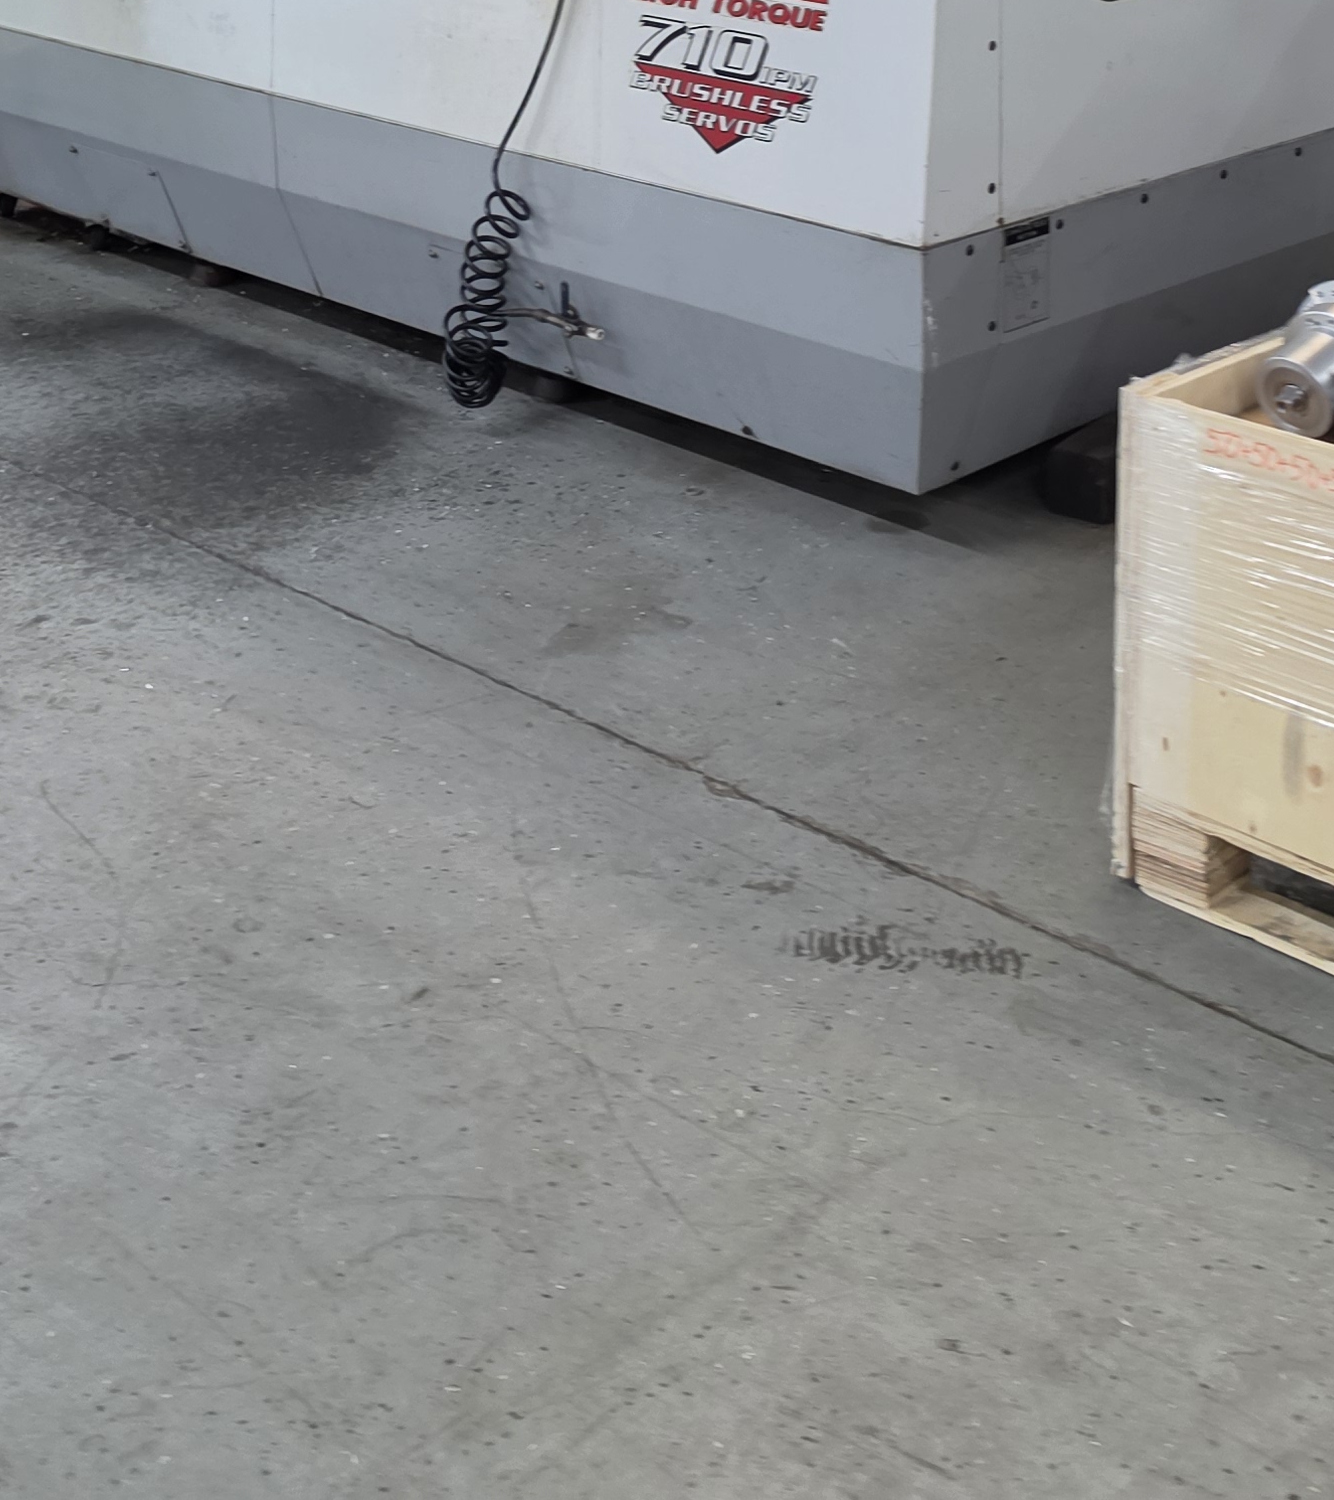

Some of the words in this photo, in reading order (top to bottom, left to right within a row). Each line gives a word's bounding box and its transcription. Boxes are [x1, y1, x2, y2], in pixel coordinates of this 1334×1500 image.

[634, 15, 770, 82] 710
[628, 70, 812, 124] BRUSHLESS
[661, 102, 777, 143] SERVOS
